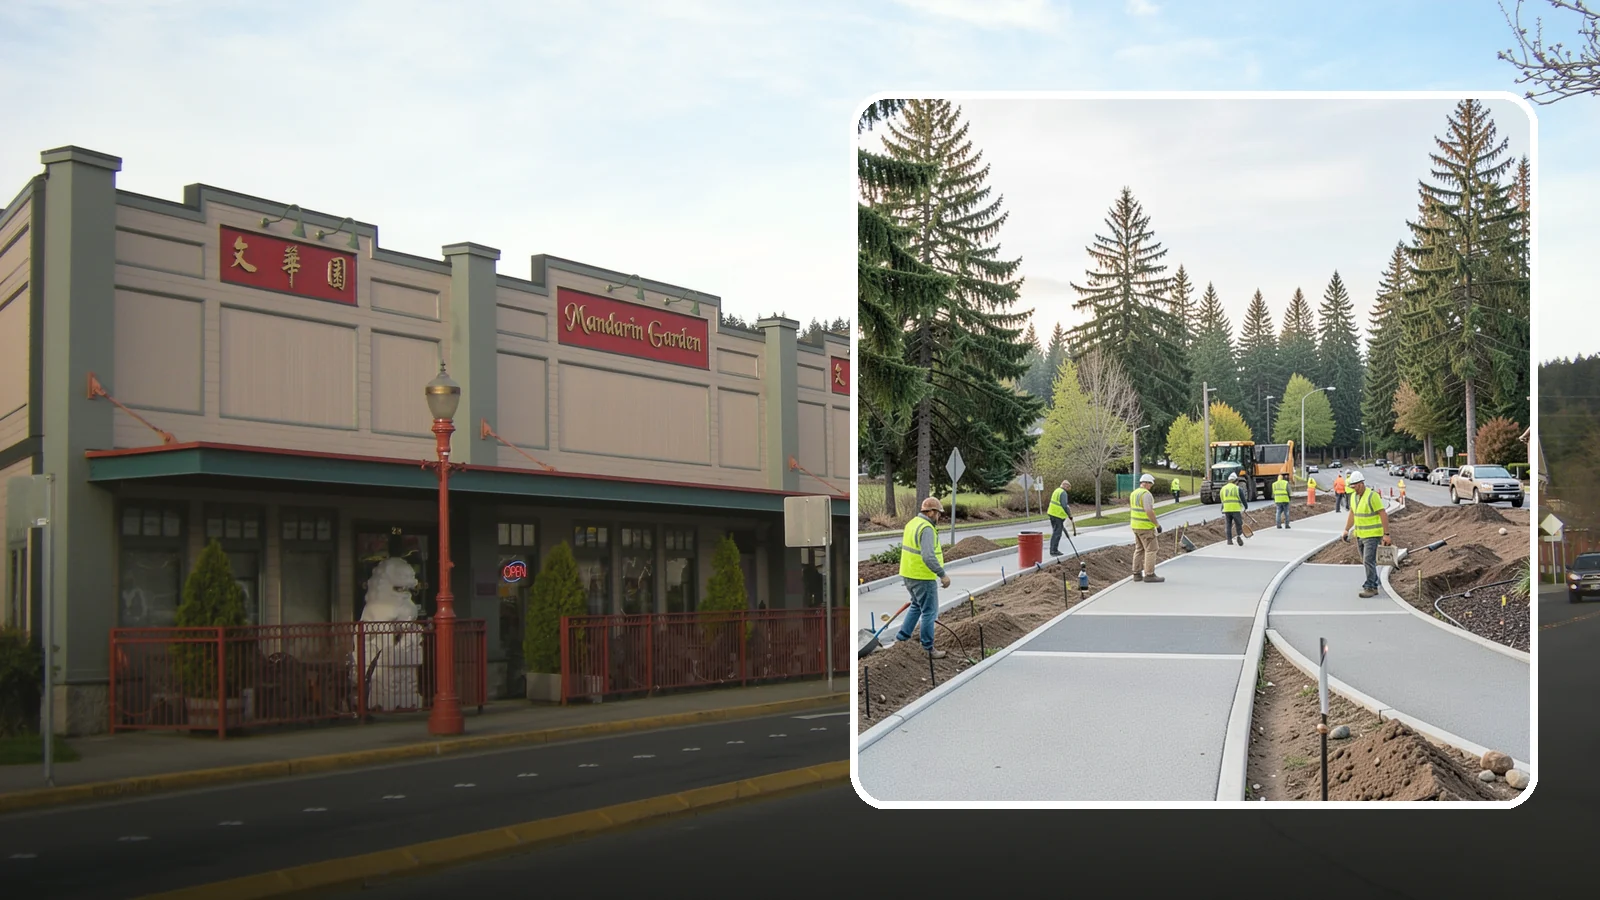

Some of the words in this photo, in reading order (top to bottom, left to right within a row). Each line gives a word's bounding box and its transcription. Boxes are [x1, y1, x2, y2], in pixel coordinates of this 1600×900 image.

[231, 236, 346, 291] 文華園
[564, 302, 644, 341] Mandarin
[647, 320, 702, 352] Garden
[503, 565, 527, 578] OPEN
